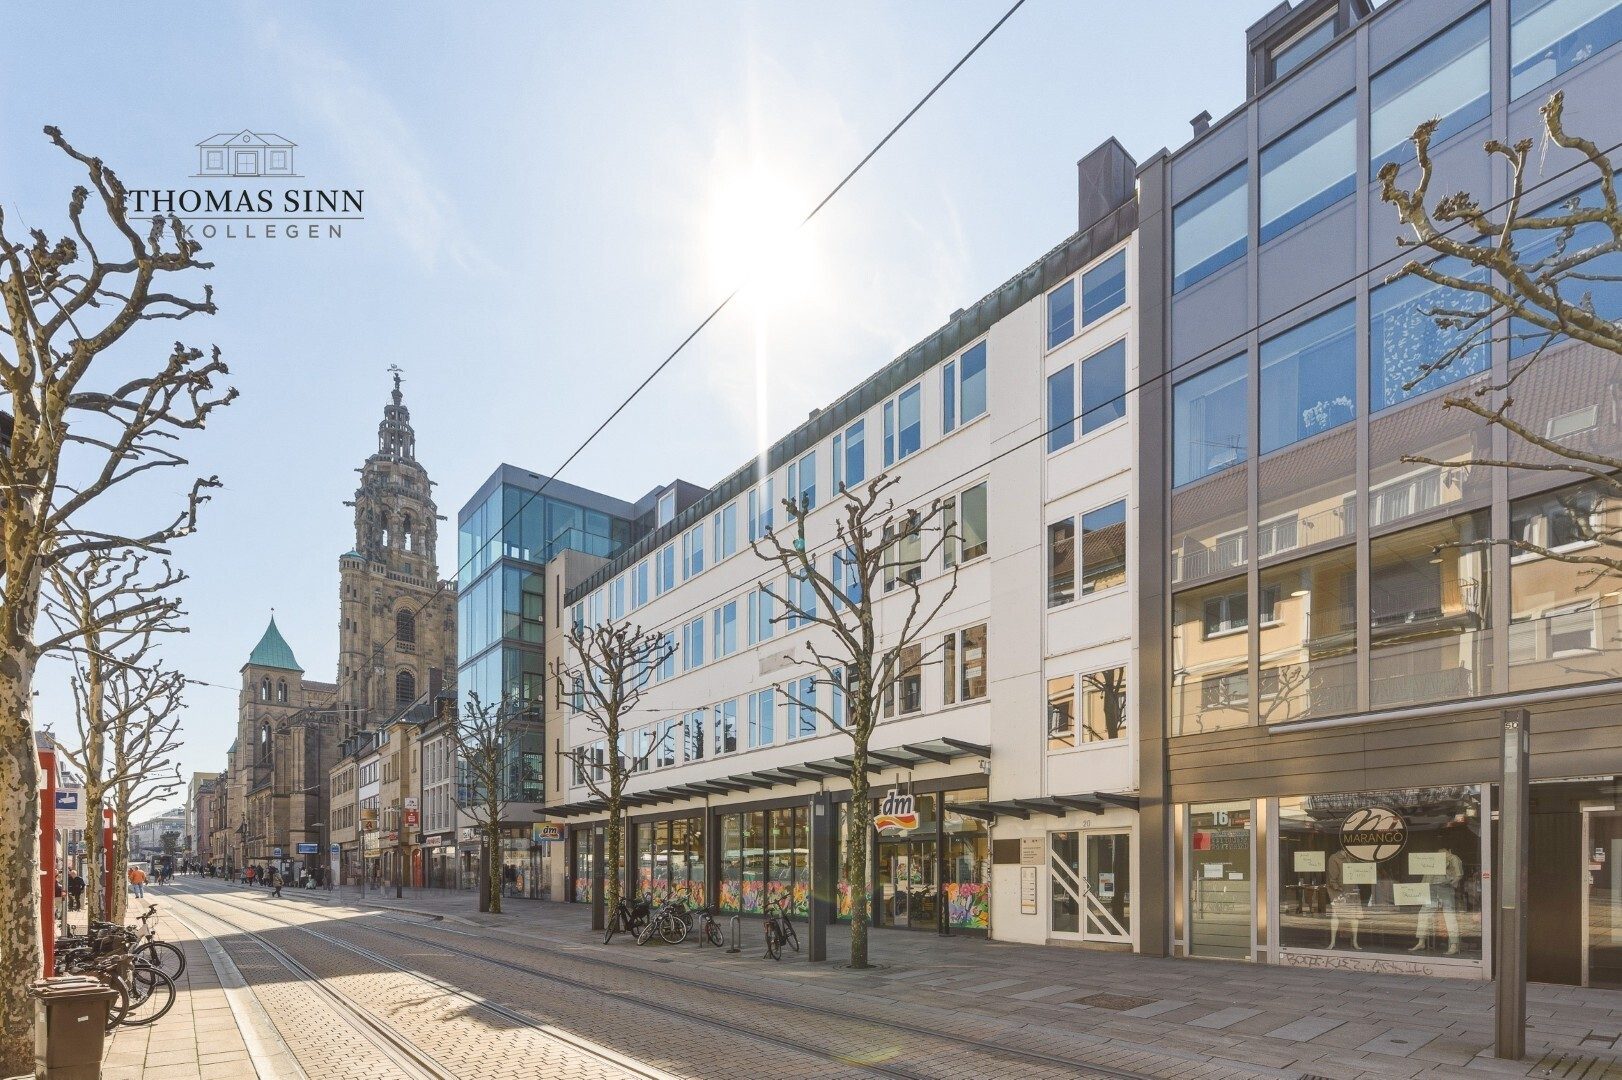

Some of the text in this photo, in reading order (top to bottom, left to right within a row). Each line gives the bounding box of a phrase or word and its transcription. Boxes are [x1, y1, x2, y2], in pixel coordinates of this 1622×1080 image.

[882, 791, 912, 815] dm
[1212, 811, 1229, 826] 16
[543, 825, 557, 834] dm
